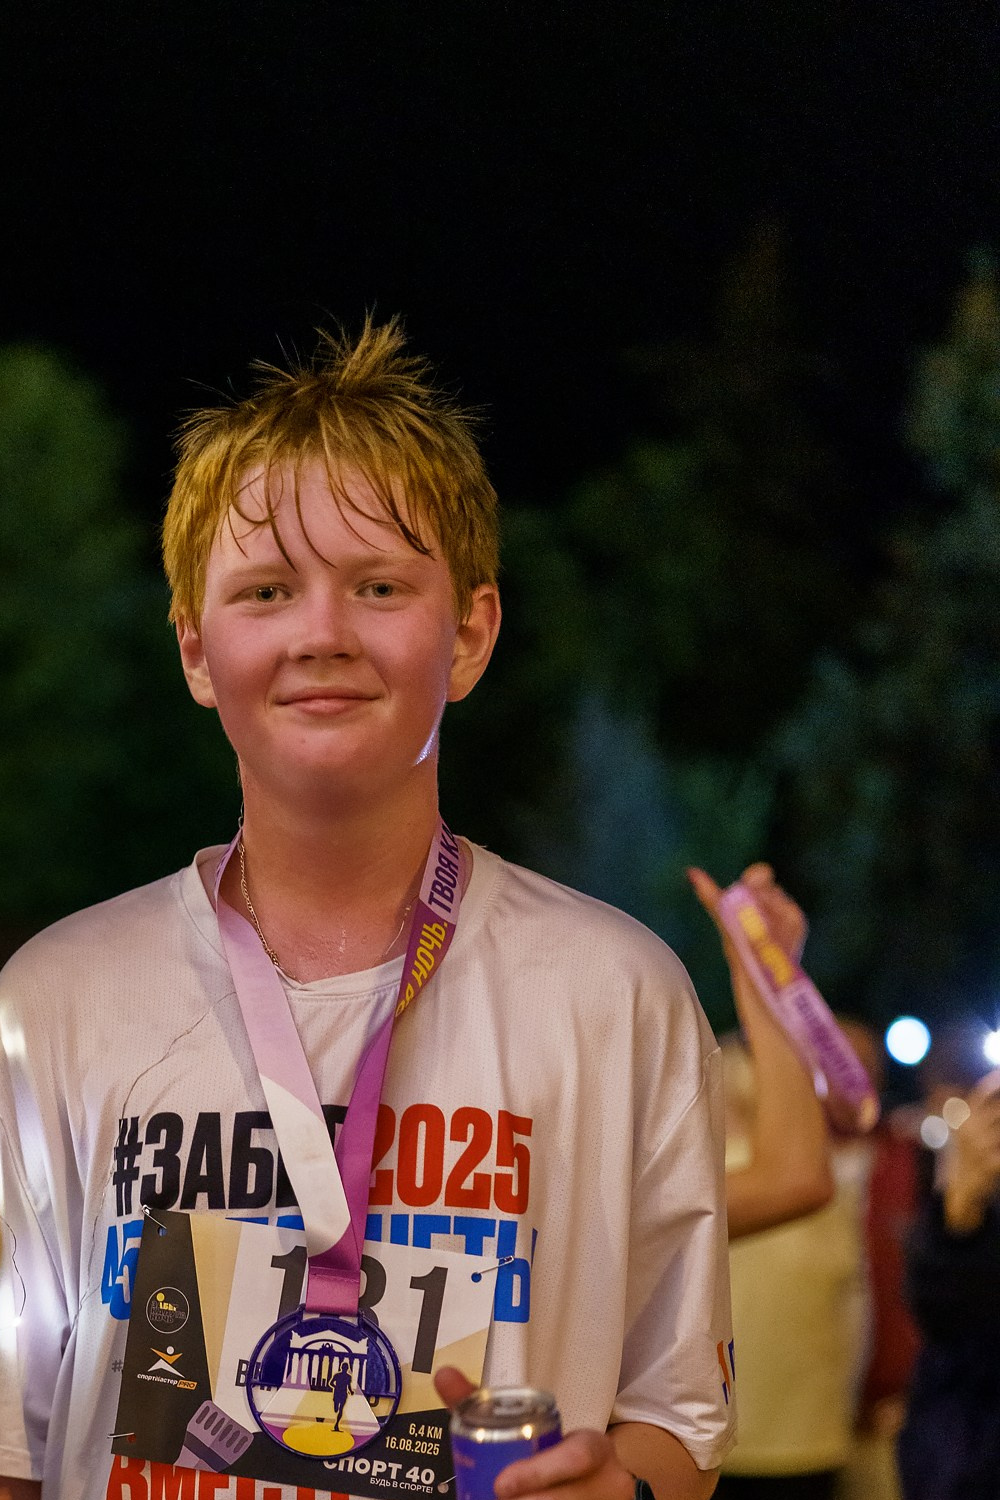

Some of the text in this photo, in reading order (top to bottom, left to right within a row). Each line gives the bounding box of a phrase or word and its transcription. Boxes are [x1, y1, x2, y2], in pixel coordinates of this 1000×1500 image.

[428, 851, 459, 914] ТВОЯ
[178, 1381, 197, 1390] PRO
[409, 1423, 443, 1439] 6,4 КМ
[385, 1436, 440, 1456] 16.08.2025
[405, 1466, 435, 1485] 40
[369, 1477, 391, 1488] БУДЬ
[399, 1481, 434, 1494] СПОРТЕ!
